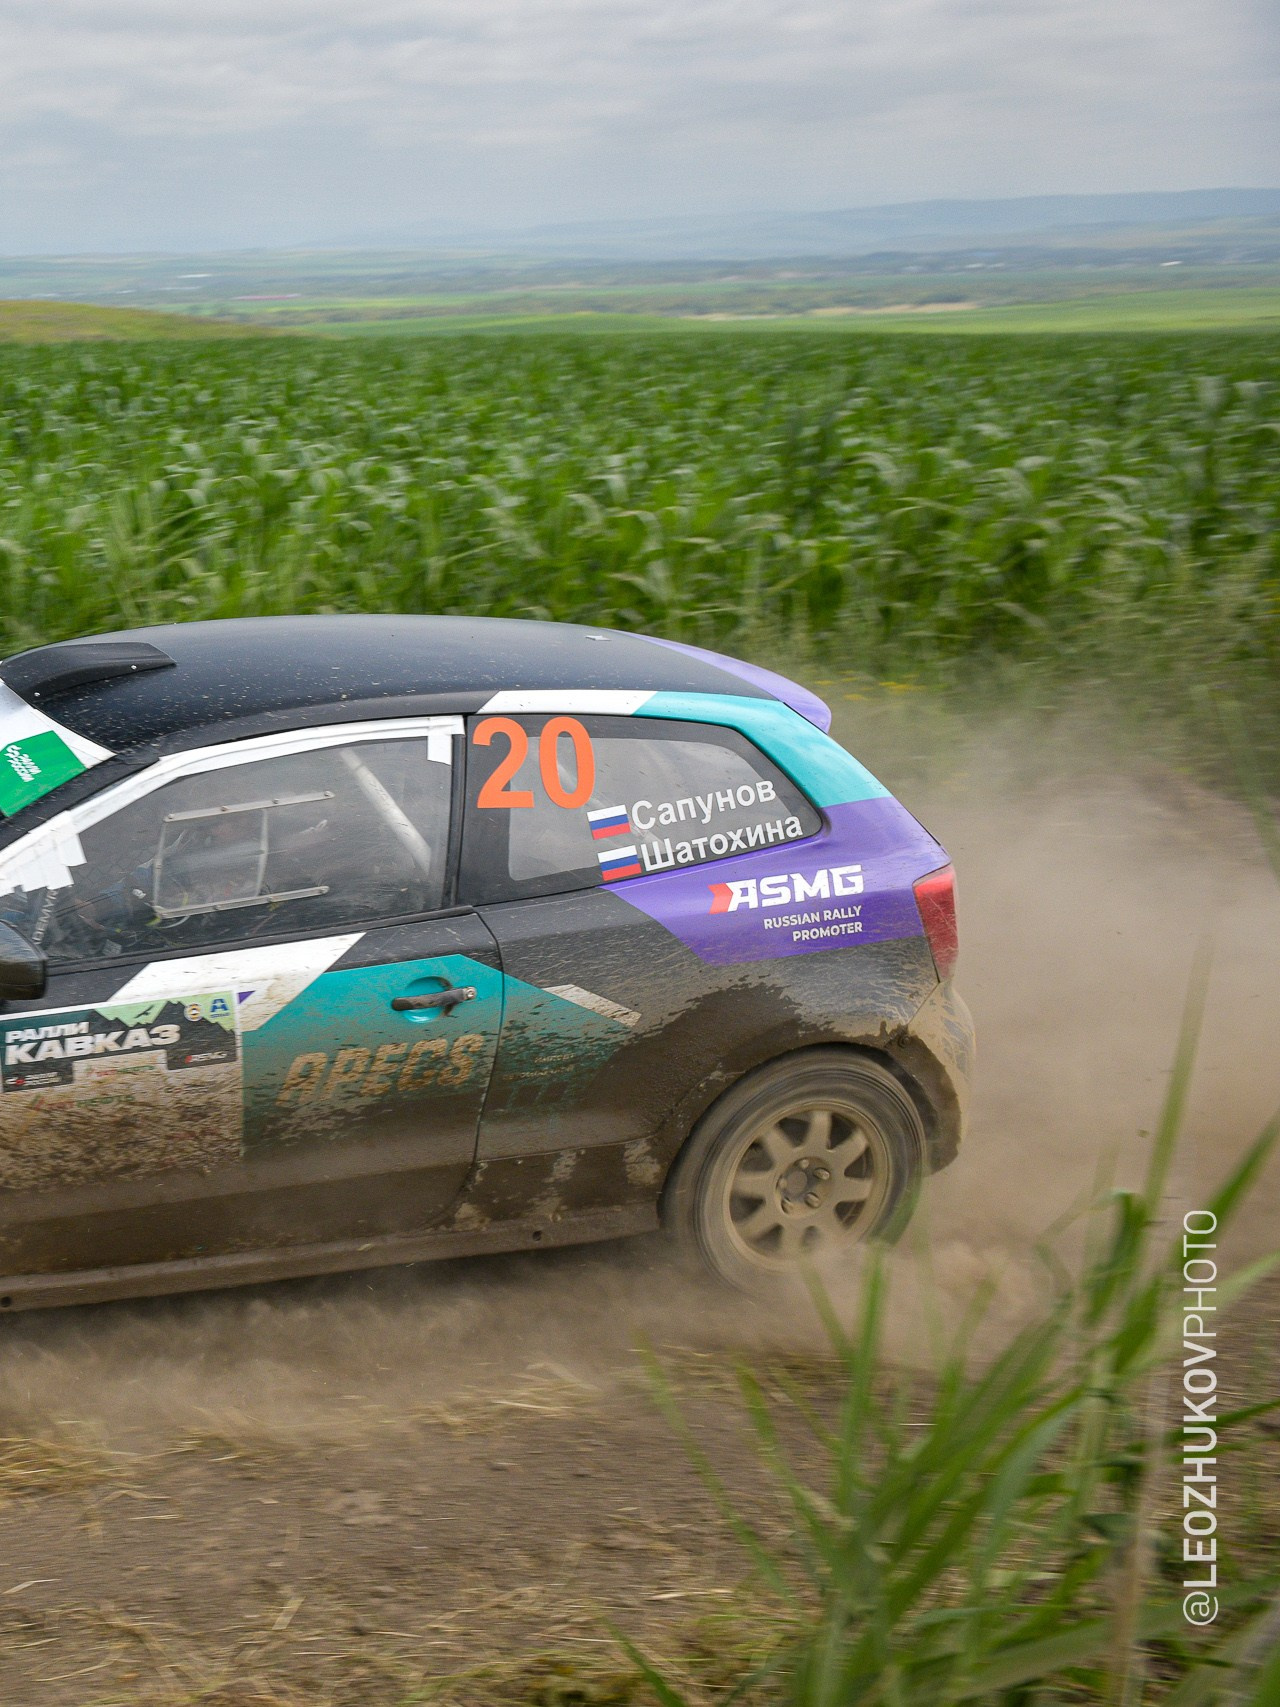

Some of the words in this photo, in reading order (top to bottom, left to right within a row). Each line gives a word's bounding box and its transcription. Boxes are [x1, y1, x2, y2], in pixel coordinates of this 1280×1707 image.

[472, 716, 596, 809] 20
[631, 780, 777, 830] Сапунов
[641, 816, 803, 871] Шатохина
[725, 864, 865, 913] ASMG
[763, 910, 821, 930] RUSSIAN
[823, 905, 862, 921] RALLY
[792, 921, 863, 942] PROMOTER
[4, 1021, 90, 1044] РАЛЛИ
[4, 1024, 181, 1066] КАВКАЗ
[275, 1033, 485, 1108] APECS
